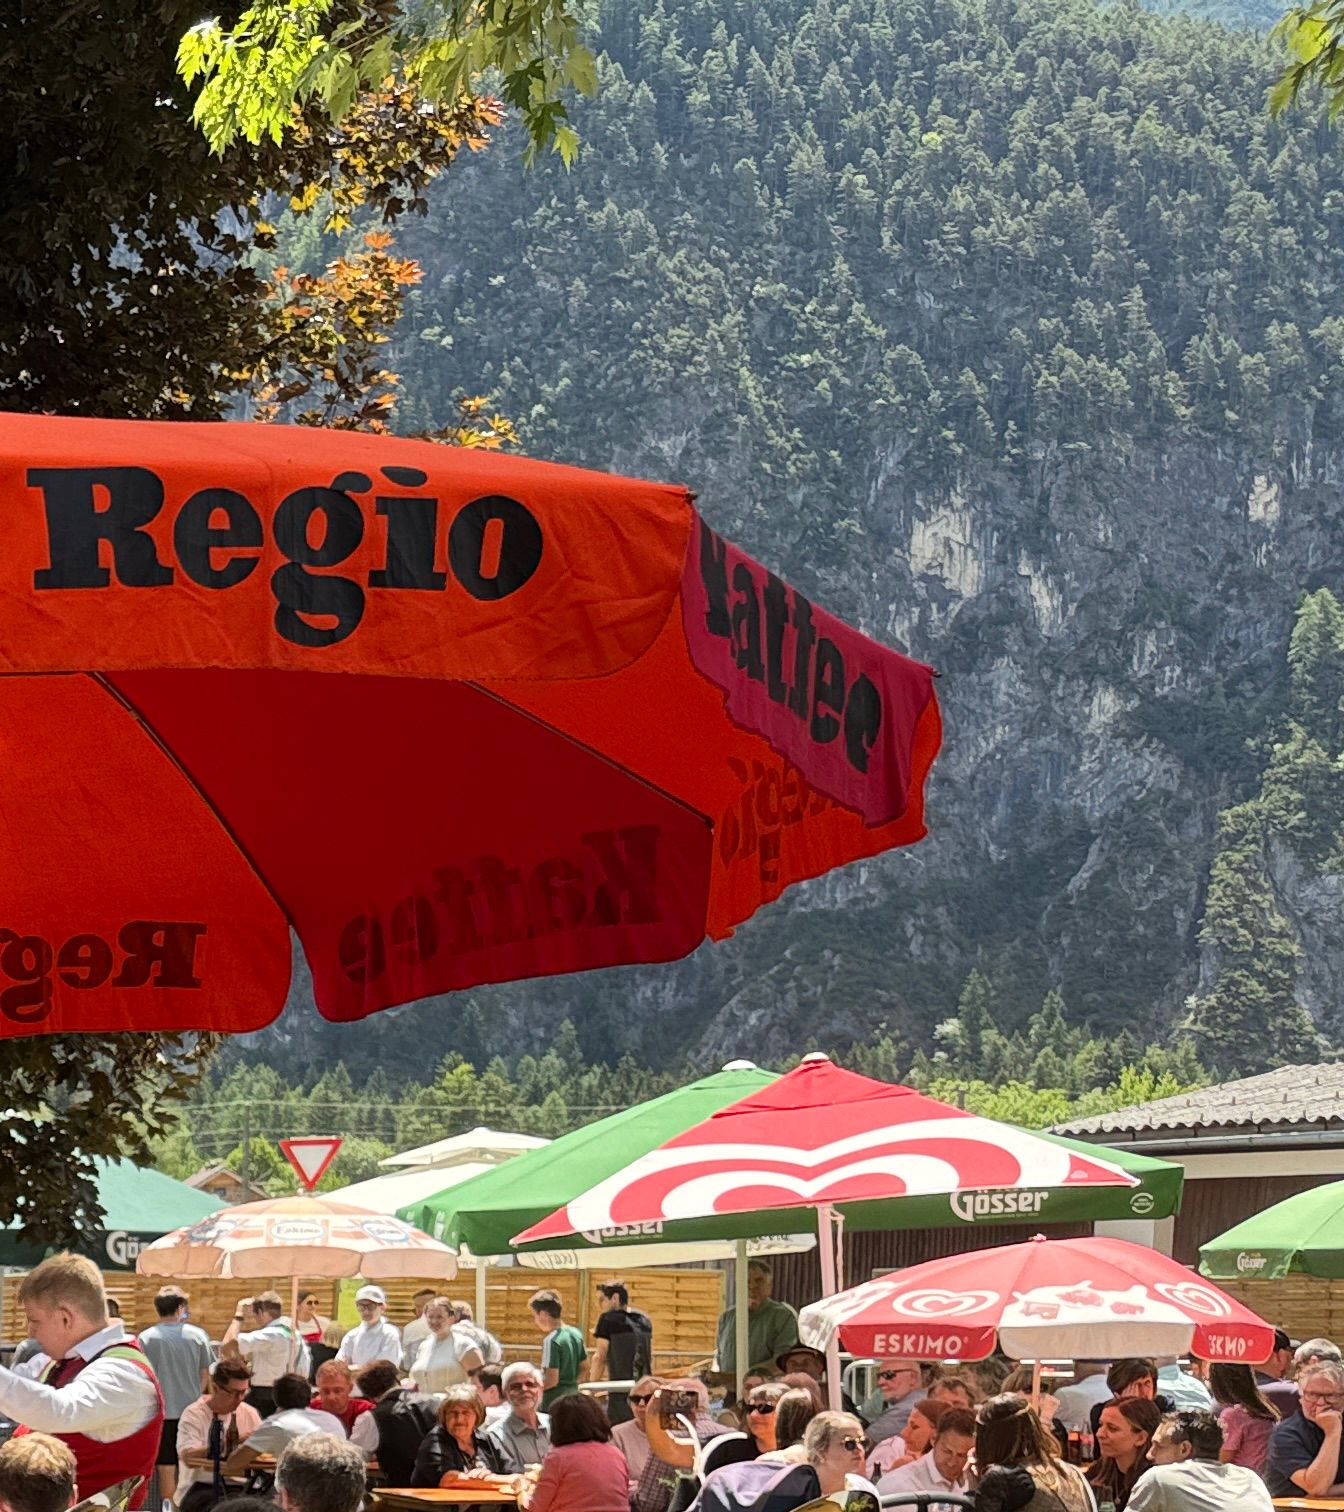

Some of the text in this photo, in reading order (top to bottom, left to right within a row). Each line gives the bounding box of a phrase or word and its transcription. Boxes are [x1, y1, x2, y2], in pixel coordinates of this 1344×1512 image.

[26, 465, 543, 648] Regio
[949, 1187, 1049, 1222] Gösser
[873, 1334, 960, 1355] ESKIMO
